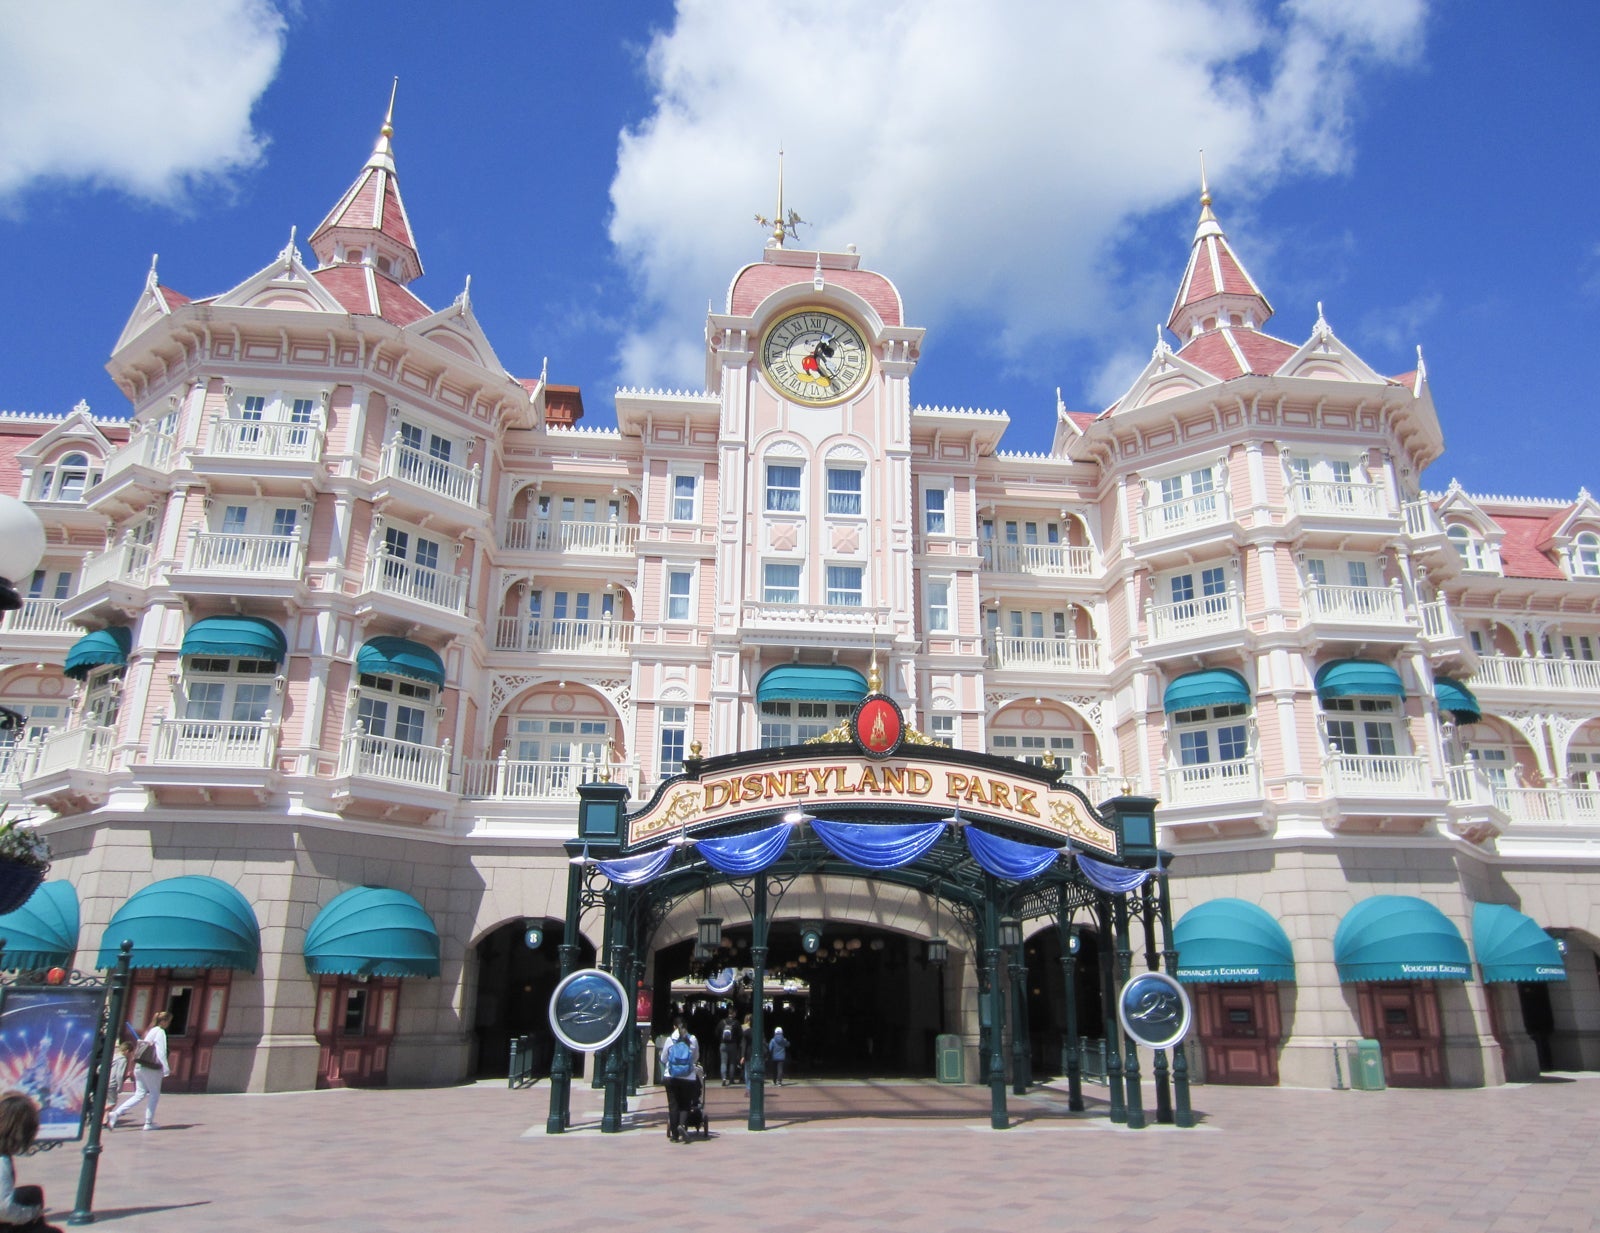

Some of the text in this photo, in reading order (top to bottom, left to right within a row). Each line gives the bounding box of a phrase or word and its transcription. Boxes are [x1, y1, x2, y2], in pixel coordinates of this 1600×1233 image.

[791, 320, 803, 332] XI
[810, 318, 822, 329] XII
[777, 334, 789, 343] X
[847, 355, 858, 363] III
[702, 766, 1041, 818] DISNEYLAND PARK
[530, 933, 538, 943] 8
[808, 938, 816, 948] 7
[1402, 964, 1438, 973] VOUCHER
[559, 989, 614, 1024] 25
[1129, 991, 1177, 1024] 25
